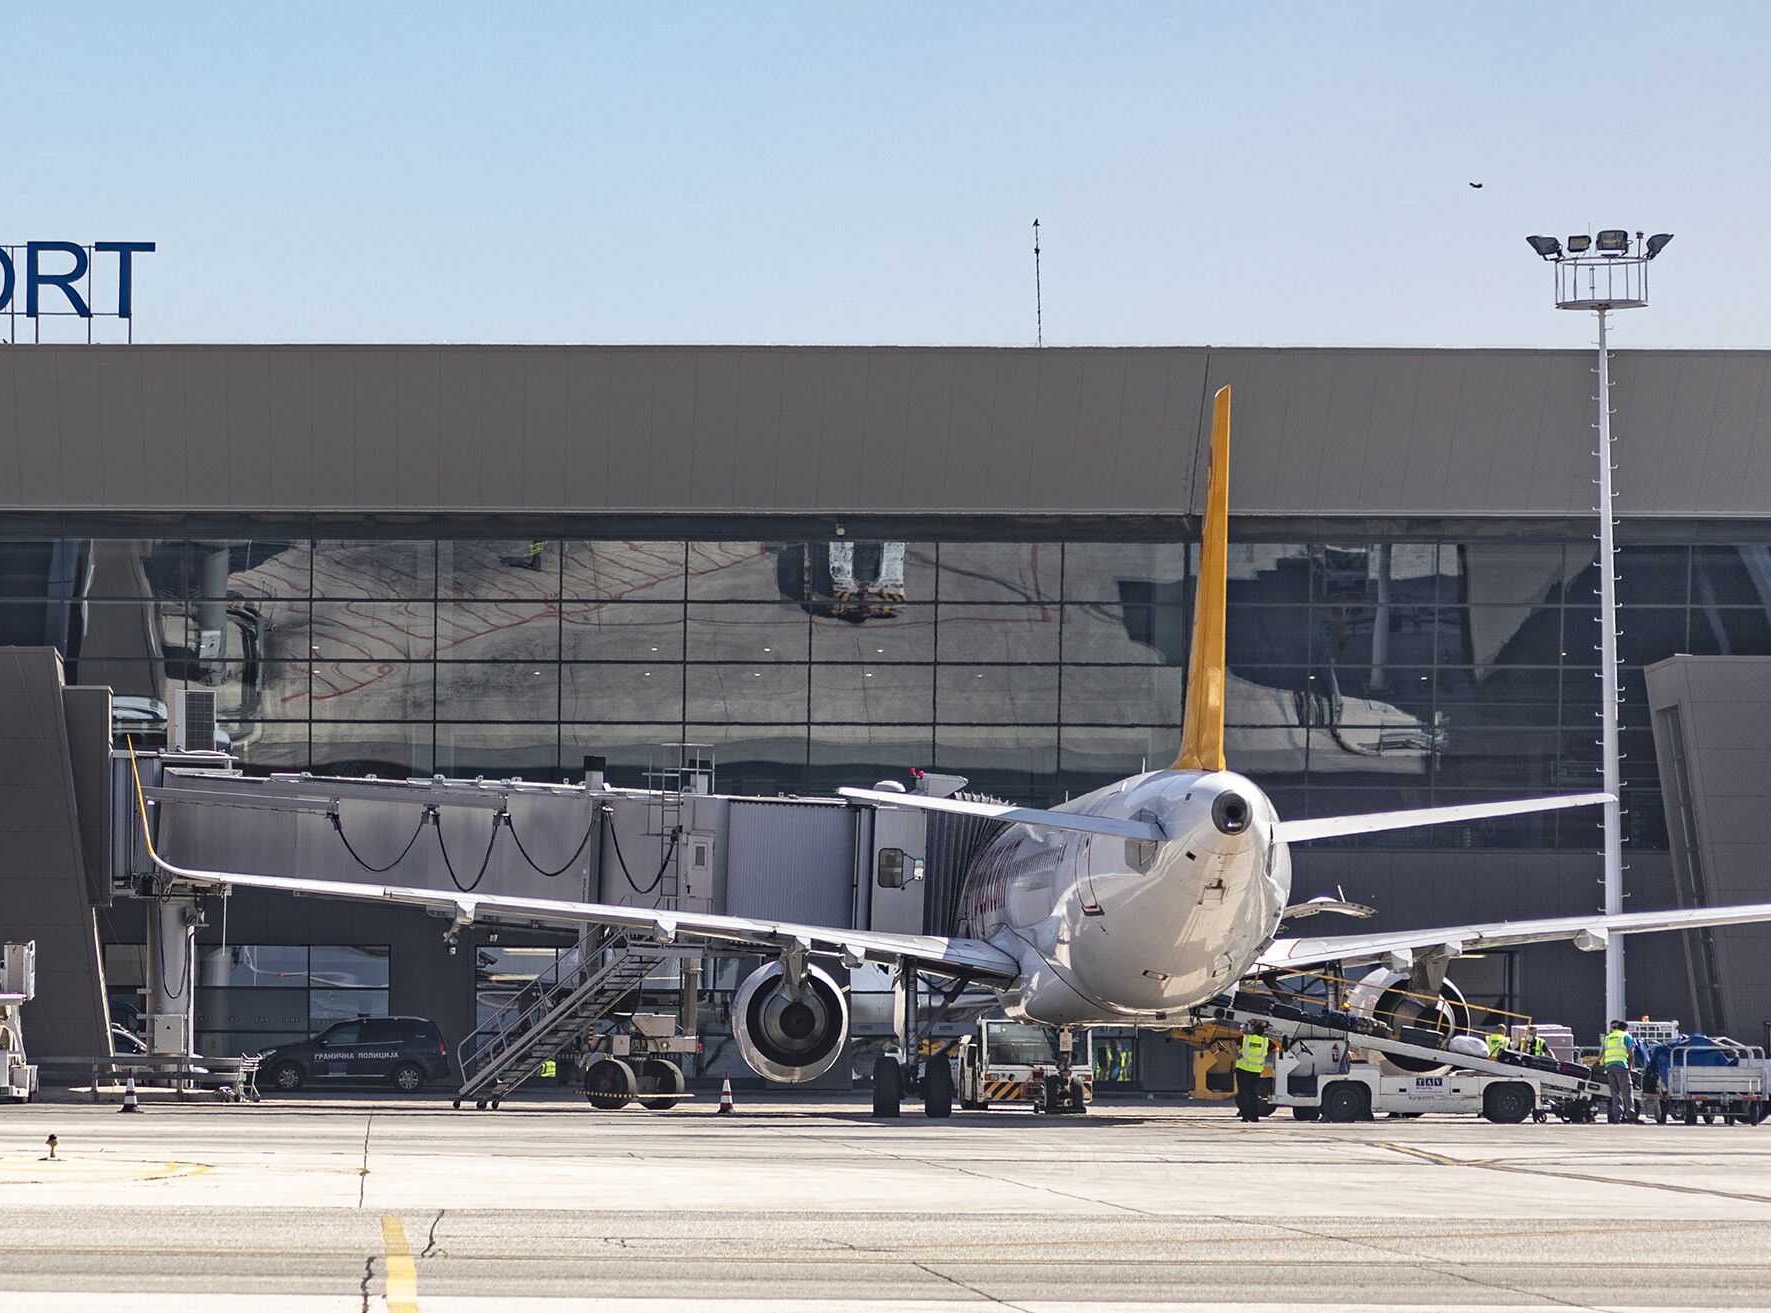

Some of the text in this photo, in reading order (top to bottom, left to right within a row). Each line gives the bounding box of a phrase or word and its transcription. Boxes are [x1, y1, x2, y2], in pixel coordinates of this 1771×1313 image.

[314, 1052, 399, 1061] ГРАНИЧНА ПОЛИЦИЈА
[1416, 1077, 1443, 1087] TAV
